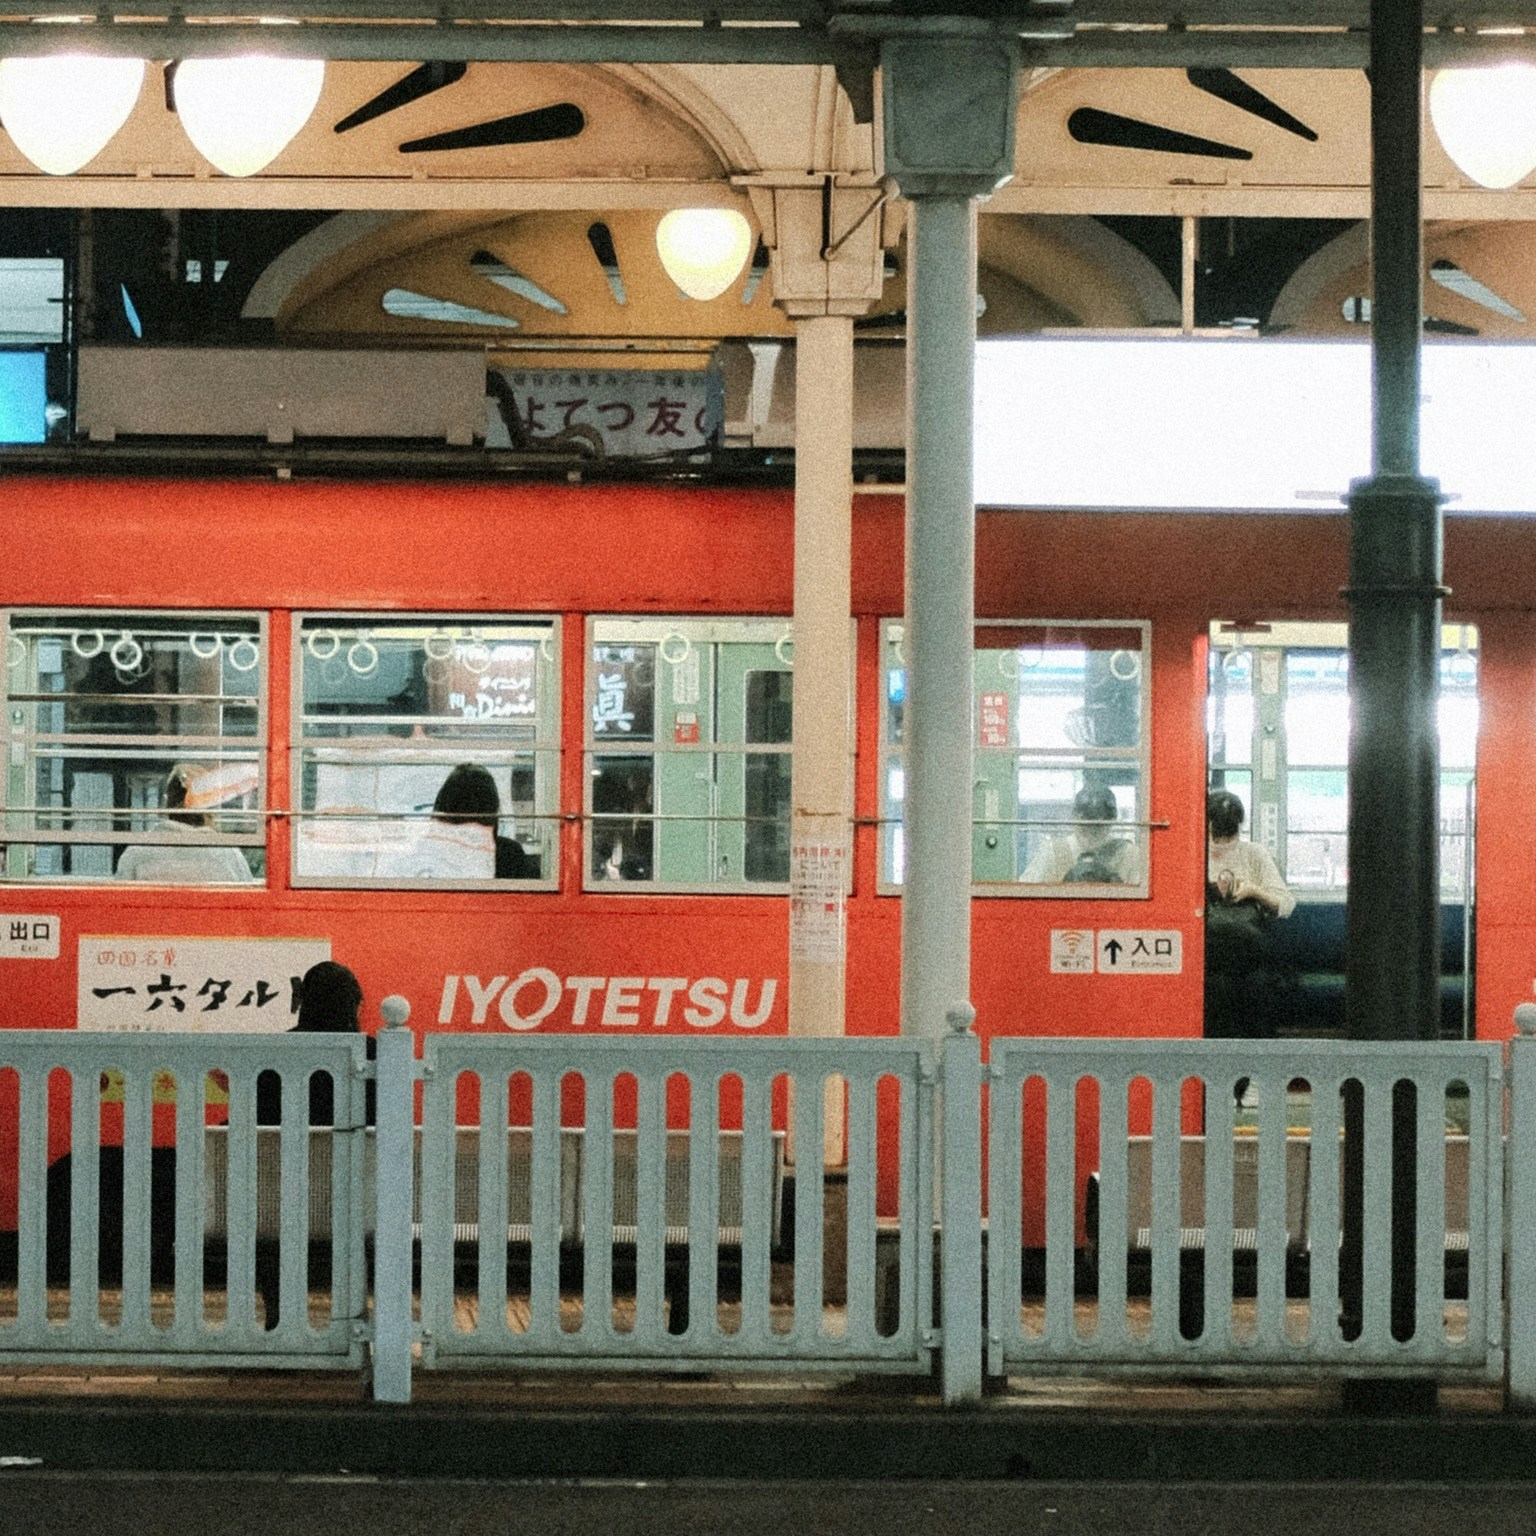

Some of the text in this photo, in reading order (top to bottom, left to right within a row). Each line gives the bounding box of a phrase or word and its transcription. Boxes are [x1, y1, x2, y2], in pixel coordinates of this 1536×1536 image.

[10, 920, 49, 941] 出口
[1130, 937, 1173, 956] 入口
[437, 966, 779, 1031] IYOTETSU
